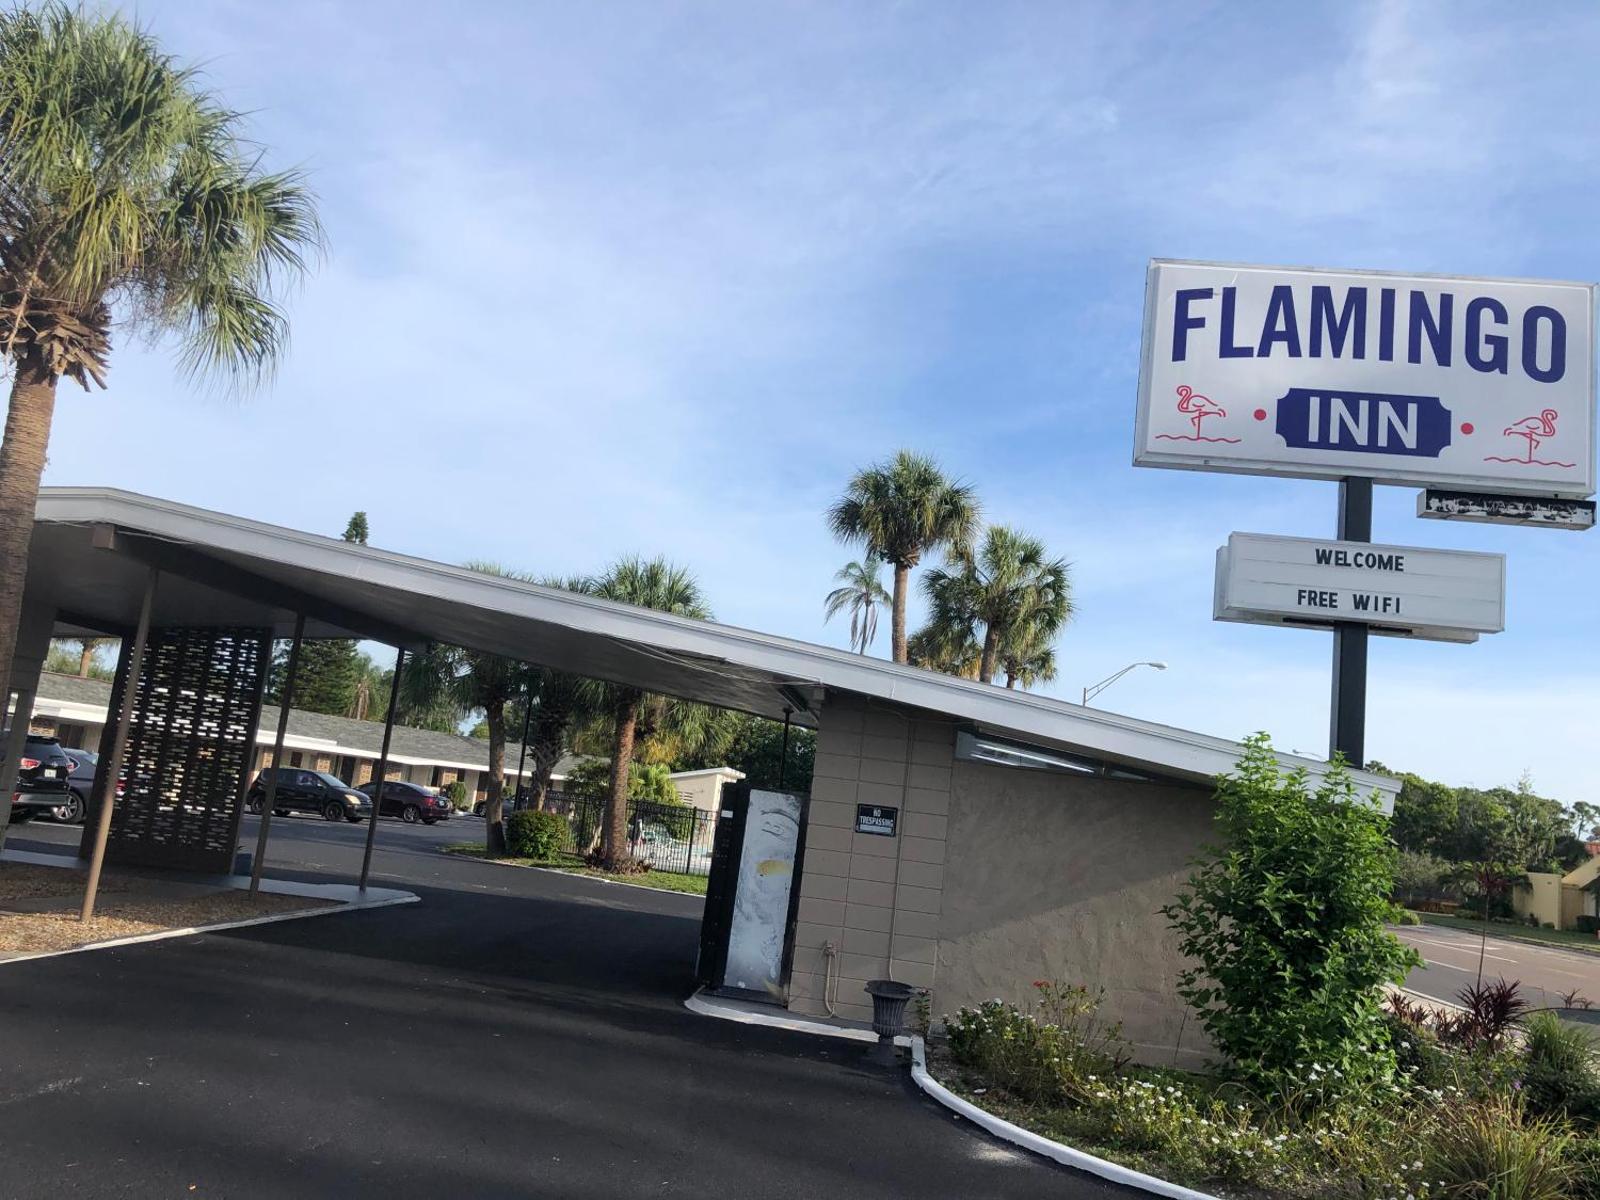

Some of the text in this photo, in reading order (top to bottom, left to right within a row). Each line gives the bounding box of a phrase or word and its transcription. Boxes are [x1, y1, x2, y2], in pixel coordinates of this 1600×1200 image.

[1171, 285, 1566, 383] FLAMINGO
[1308, 396, 1418, 449] INN
[1315, 548, 1404, 572] WELCOME
[1297, 589, 1400, 613] FREE WIFI
